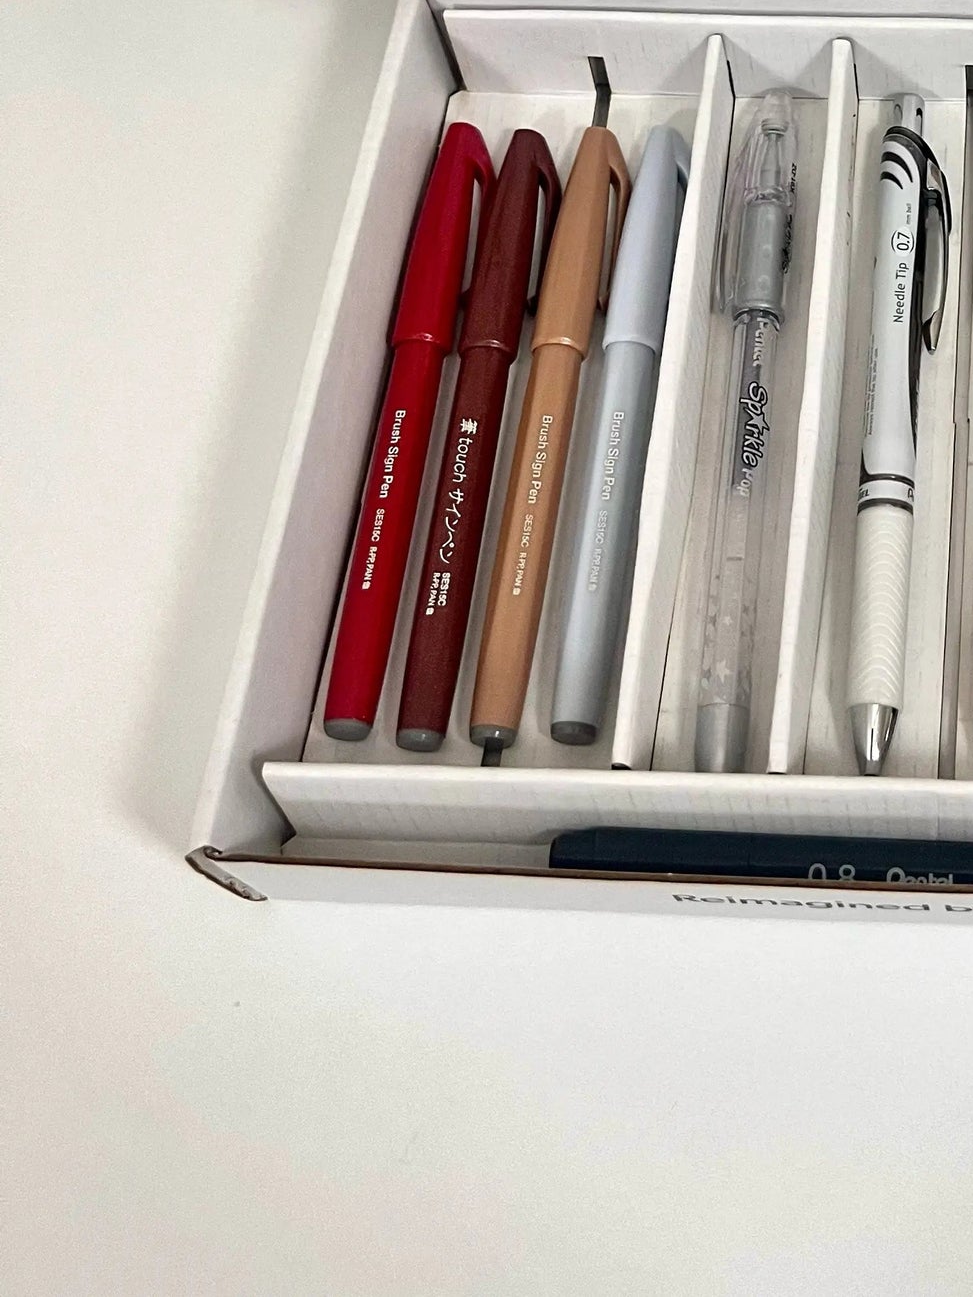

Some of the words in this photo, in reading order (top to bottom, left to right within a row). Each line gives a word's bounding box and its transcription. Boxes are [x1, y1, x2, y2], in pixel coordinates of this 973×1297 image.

[895, 230, 911, 252] 0.7
[895, 262, 910, 280] Tip
[892, 283, 906, 323] Needle
[389, 408, 407, 444] Brush
[535, 415, 553, 449] Brush
[383, 445, 400, 474] Sign
[451, 437, 474, 483] touch
[531, 451, 547, 478] Sign
[378, 475, 394, 499] Pen
[528, 480, 542, 504] Pen
[439, 487, 465, 564] サインペン
[671, 893, 931, 912] Reimagined
